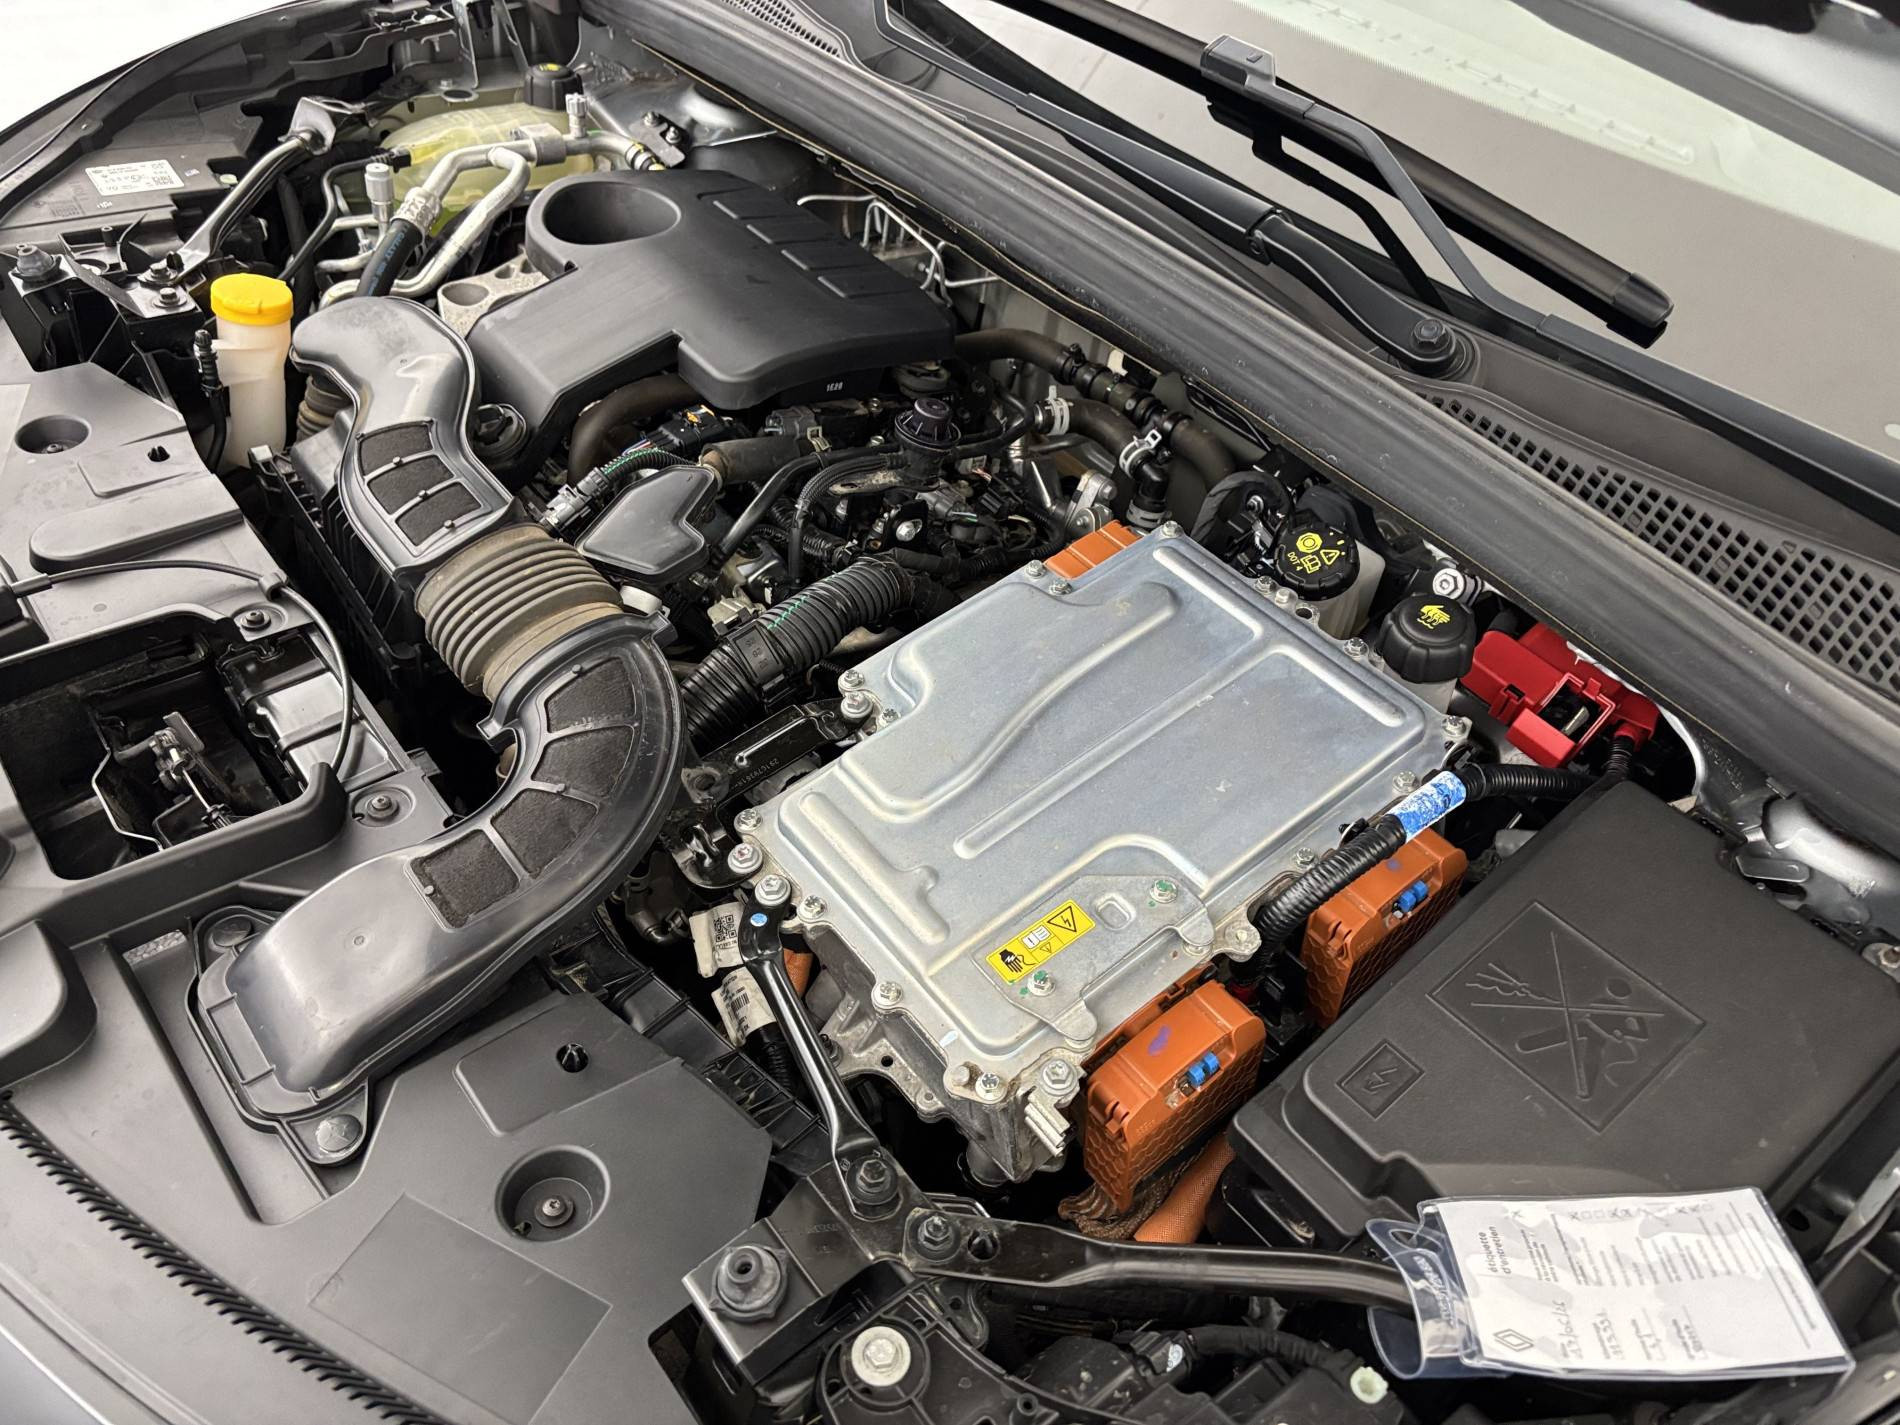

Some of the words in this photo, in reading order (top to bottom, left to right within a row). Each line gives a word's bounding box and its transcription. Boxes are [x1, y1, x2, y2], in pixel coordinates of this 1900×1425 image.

[1287, 551, 1301, 565] DOT
[1478, 1231, 1499, 1273] étiquette
[1488, 1226, 1512, 1274] d'entretien
